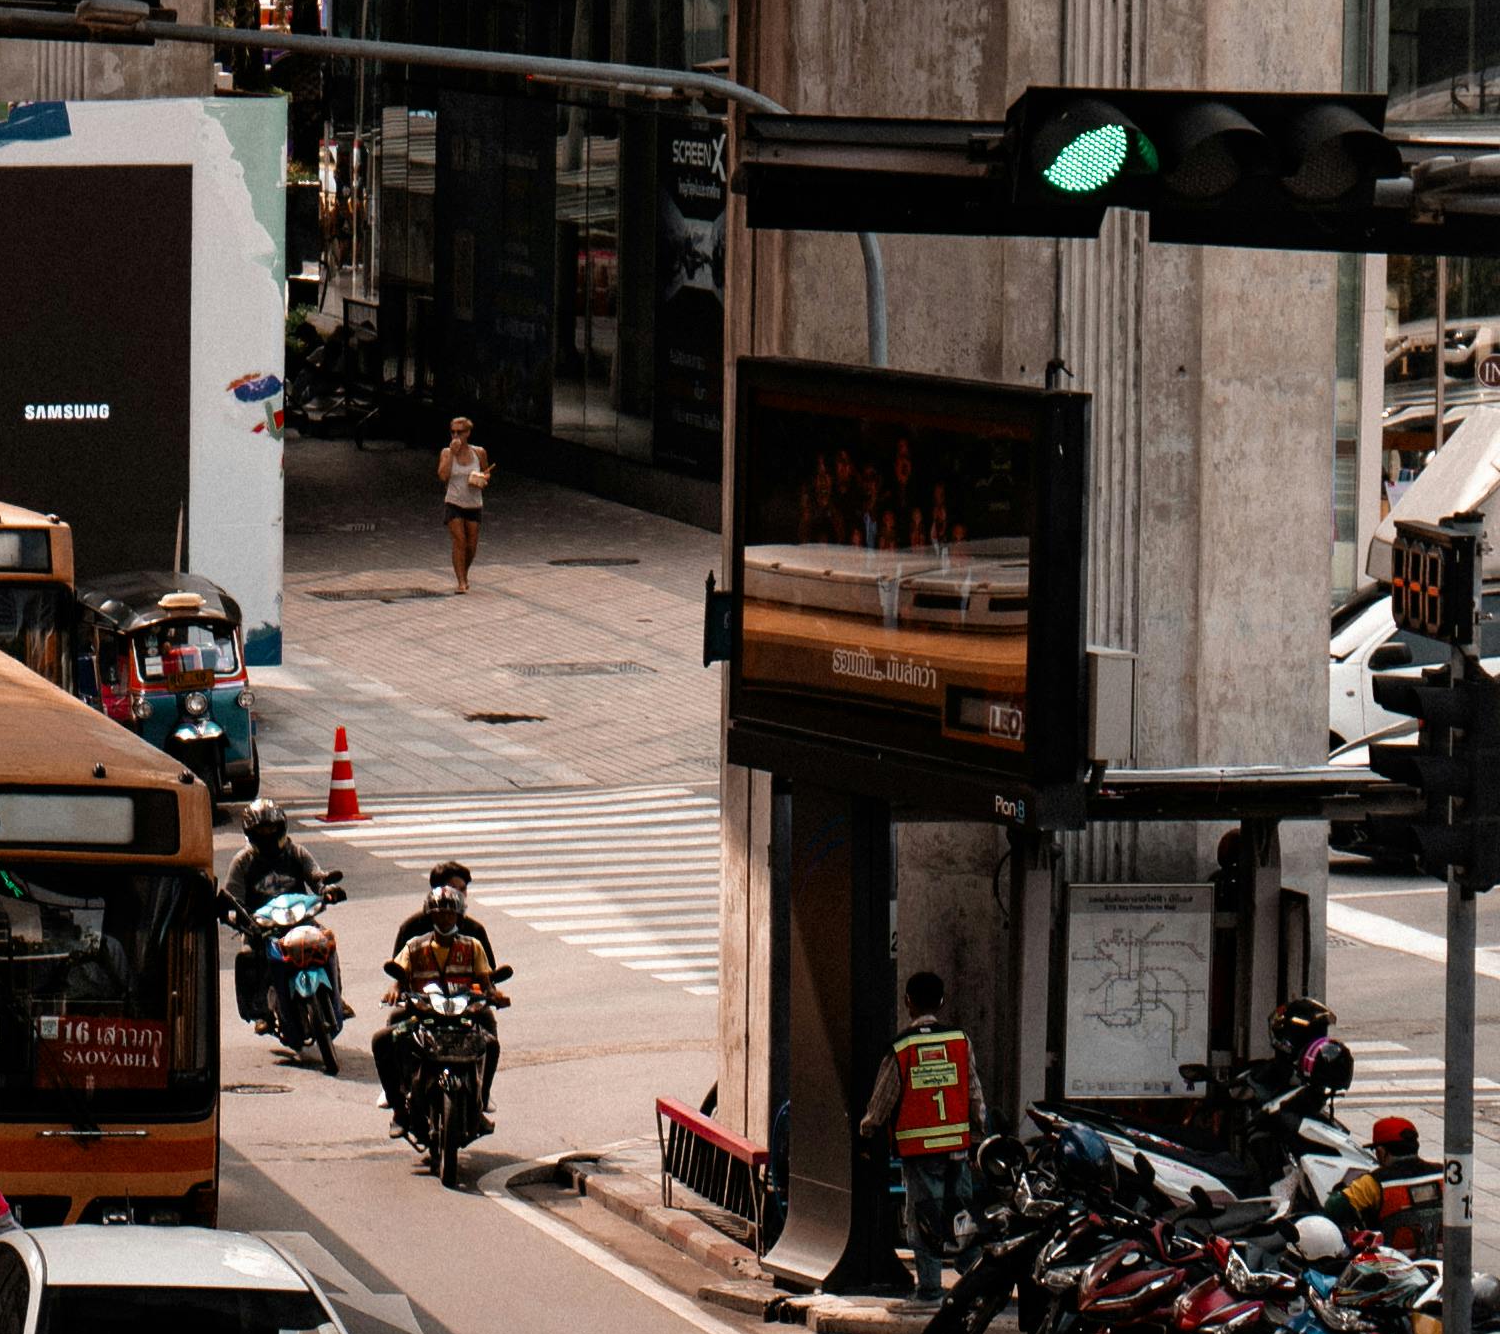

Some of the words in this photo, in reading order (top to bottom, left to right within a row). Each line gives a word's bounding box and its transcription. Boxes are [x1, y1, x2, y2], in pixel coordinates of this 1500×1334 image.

[23, 403, 111, 421] SAMSUNG
[63, 1020, 91, 1044] 16
[61, 1046, 161, 1069] SAOVABHA
[932, 1089, 947, 1121] 1
